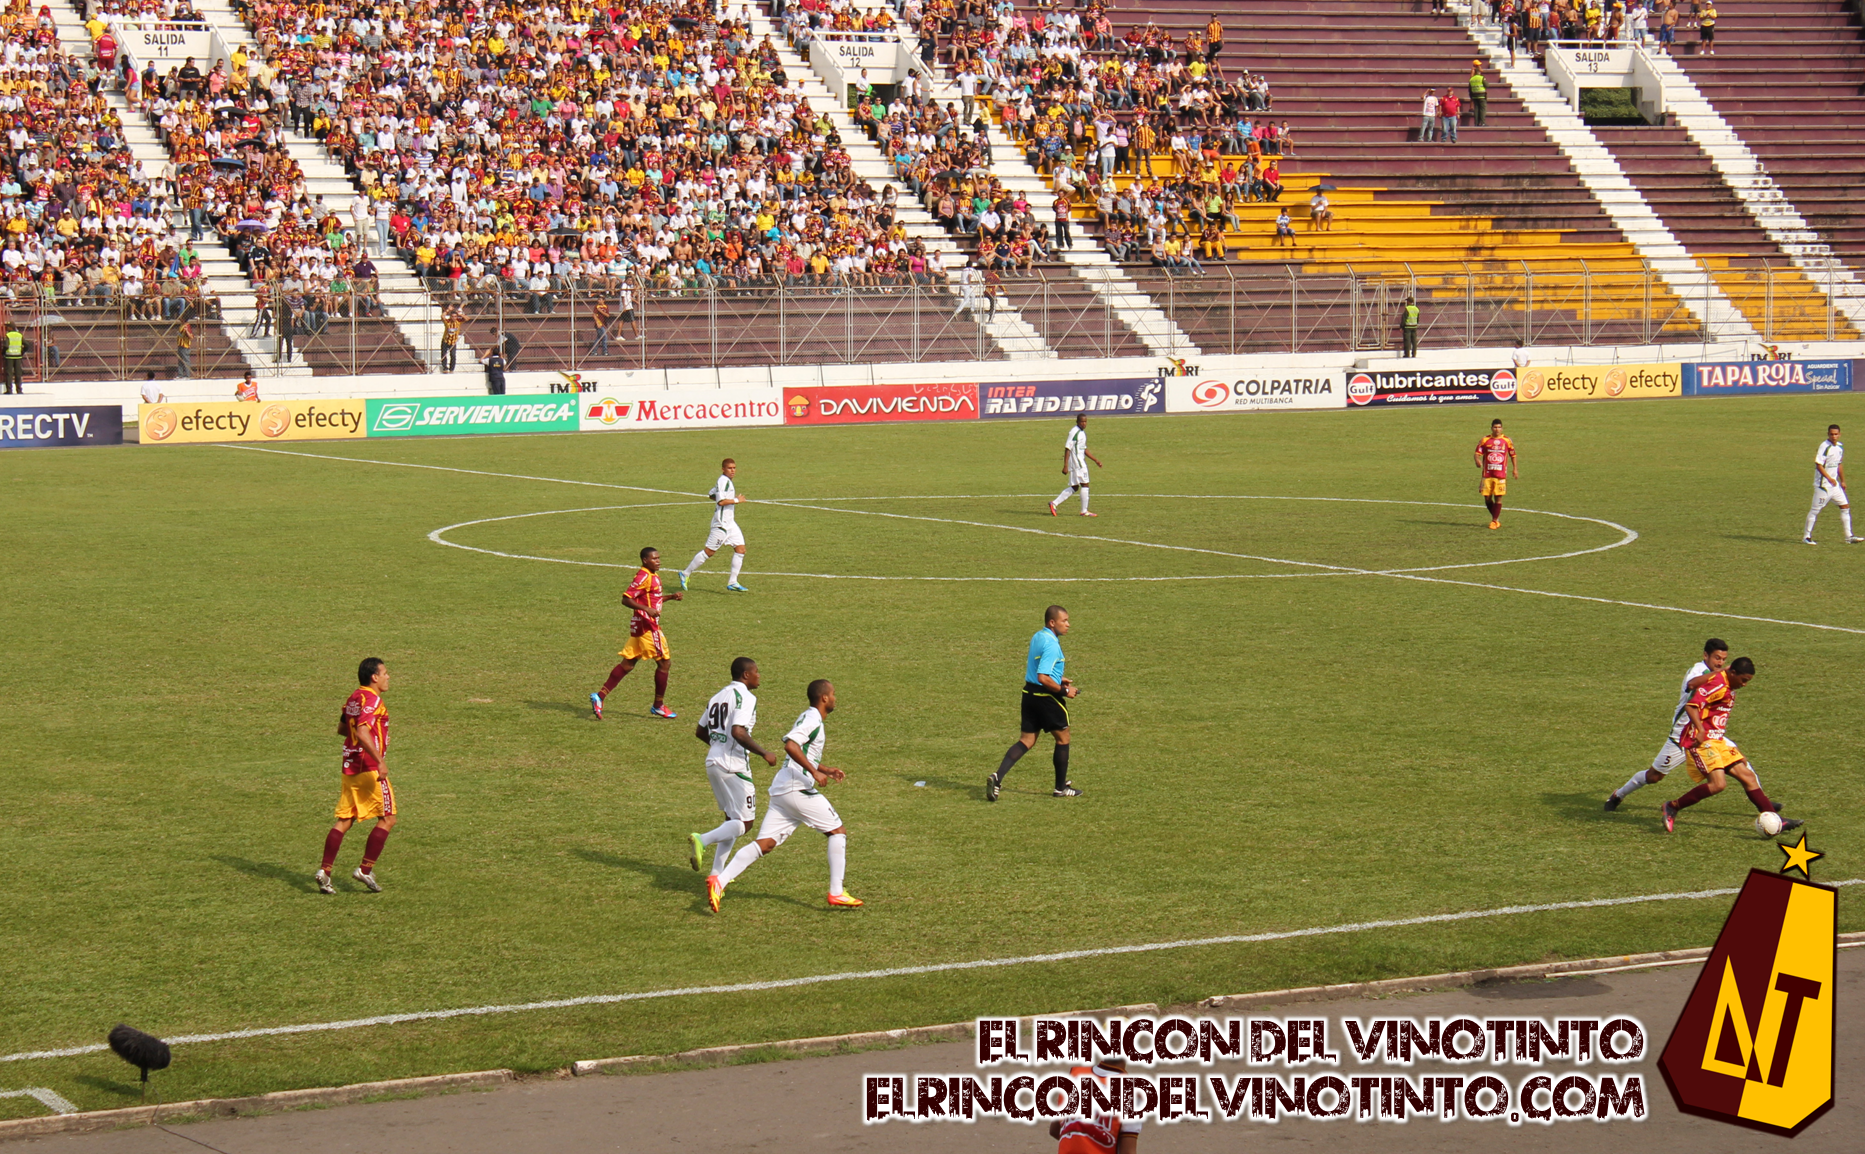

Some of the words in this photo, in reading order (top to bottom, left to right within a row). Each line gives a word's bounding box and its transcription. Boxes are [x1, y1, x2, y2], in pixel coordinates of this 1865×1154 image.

[144, 33, 186, 45] SALIDA
[157, 45, 169, 57] 11
[839, 45, 875, 57] SALIDA
[1575, 52, 1611, 62] SALIDA
[849, 57, 861, 68] 12
[1587, 62, 1599, 73] 13
[1376, 372, 1490, 390] lubricantes
[1629, 370, 1679, 393] efecty
[1697, 364, 1754, 388] TAPA
[1755, 362, 1808, 386] ROJA
[988, 385, 1037, 398] INTER
[1233, 378, 1333, 397] COLPATRIA
[1349, 383, 1374, 397] Gulf
[1492, 380, 1516, 393] Gulf
[1547, 372, 1599, 395] efecty
[819, 395, 975, 417] DAVIVIENDA
[985, 394, 1134, 414] RAPIDISIMO
[1234, 398, 1248, 406] RED
[1249, 396, 1294, 405] MULTIBANCA
[1386, 394, 1428, 403] Cuidamos
[1429, 393, 1437, 402] lo
[1438, 395, 1454, 404] que
[415, 403, 575, 426] SERVIENTREGA
[635, 399, 779, 423] Mercacentro
[181, 409, 251, 436] efecty
[295, 406, 363, 434] efecty
[708, 702, 729, 731] 90
[1663, 756, 1672, 765] 5
